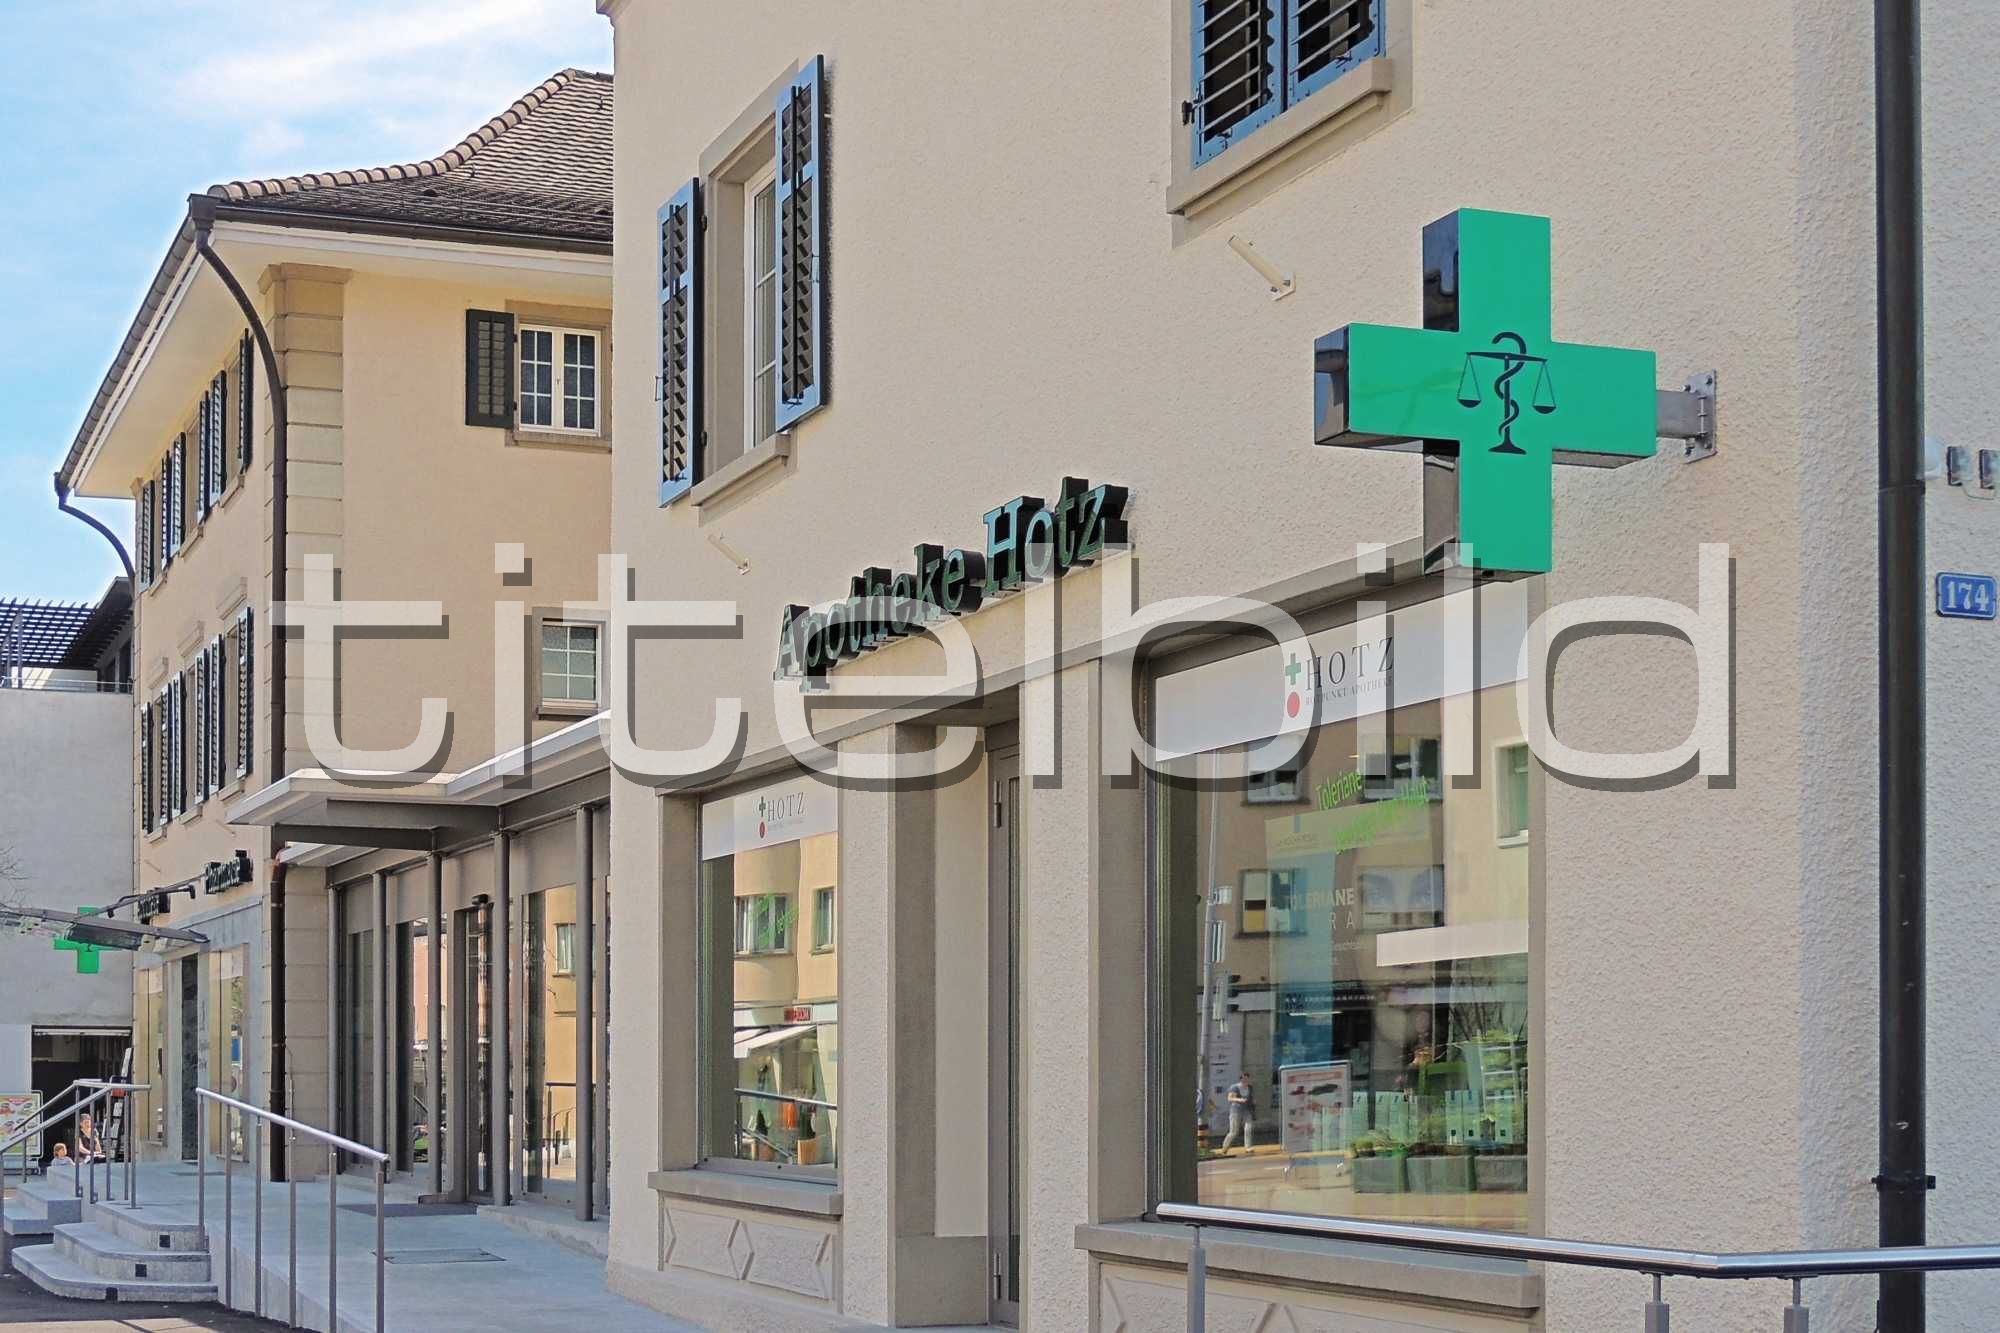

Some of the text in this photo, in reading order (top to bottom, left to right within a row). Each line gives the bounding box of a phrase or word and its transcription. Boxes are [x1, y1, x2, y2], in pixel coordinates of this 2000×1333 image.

[774, 476, 1128, 694] Apotheke Hotz
[1946, 581, 1989, 612] 174
[1305, 636, 1393, 691] HOTZ
[767, 791, 805, 822] HOTZ
[1315, 767, 1362, 811] Toleriane
